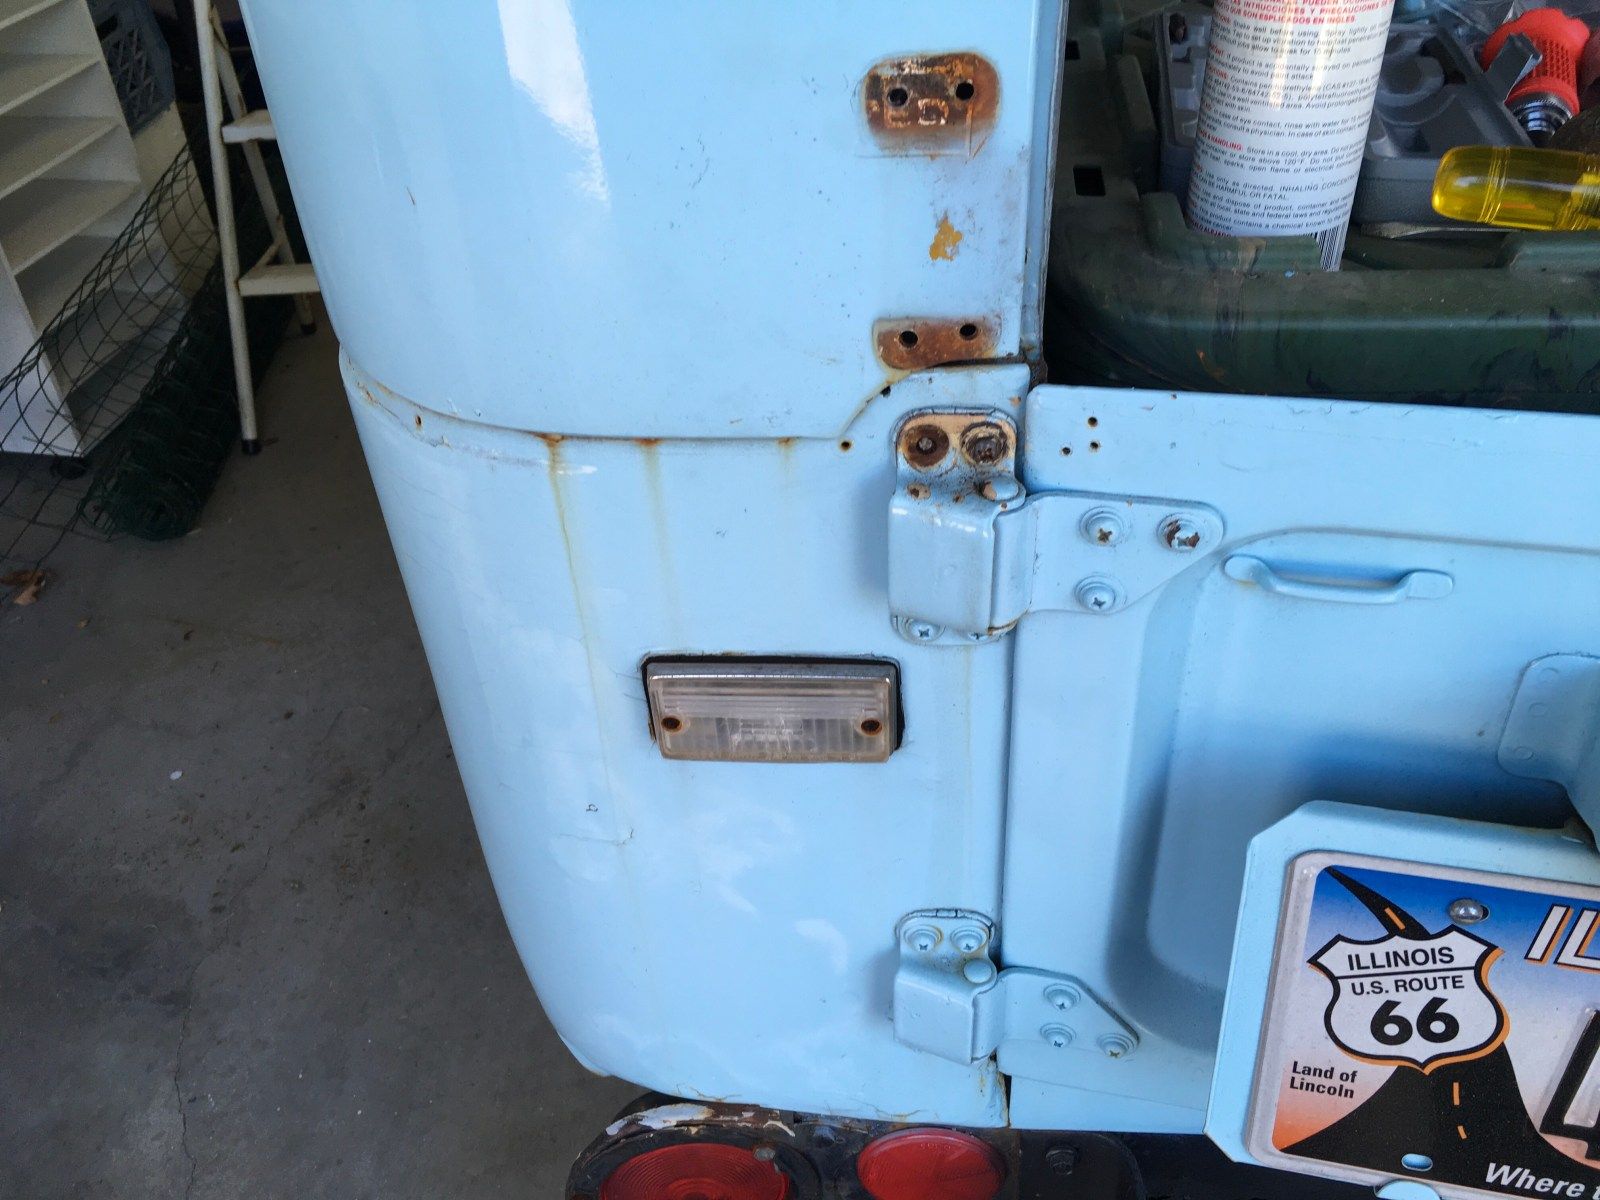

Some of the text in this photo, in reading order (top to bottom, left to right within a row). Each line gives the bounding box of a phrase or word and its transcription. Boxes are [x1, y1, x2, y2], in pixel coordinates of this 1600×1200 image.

[1243, 10, 1258, 20] SON
[1270, 27, 1294, 35] before
[1251, 43, 1269, 52] allow
[1305, 101, 1327, 109] Avoid
[1246, 146, 1266, 155] Store
[1300, 150, 1312, 158] dry
[1258, 156, 1281, 164] above
[1248, 165, 1267, 173] open
[1279, 184, 1319, 193] INHALING
[1347, 946, 1455, 971] ILLINOIS
[1351, 974, 1465, 996] U.S. ROUTE
[1370, 996, 1460, 1046] 66
[1292, 1061, 1358, 1084] Land of
[1289, 1076, 1355, 1099] Lincoln
[1484, 1162, 1582, 1200] Where
